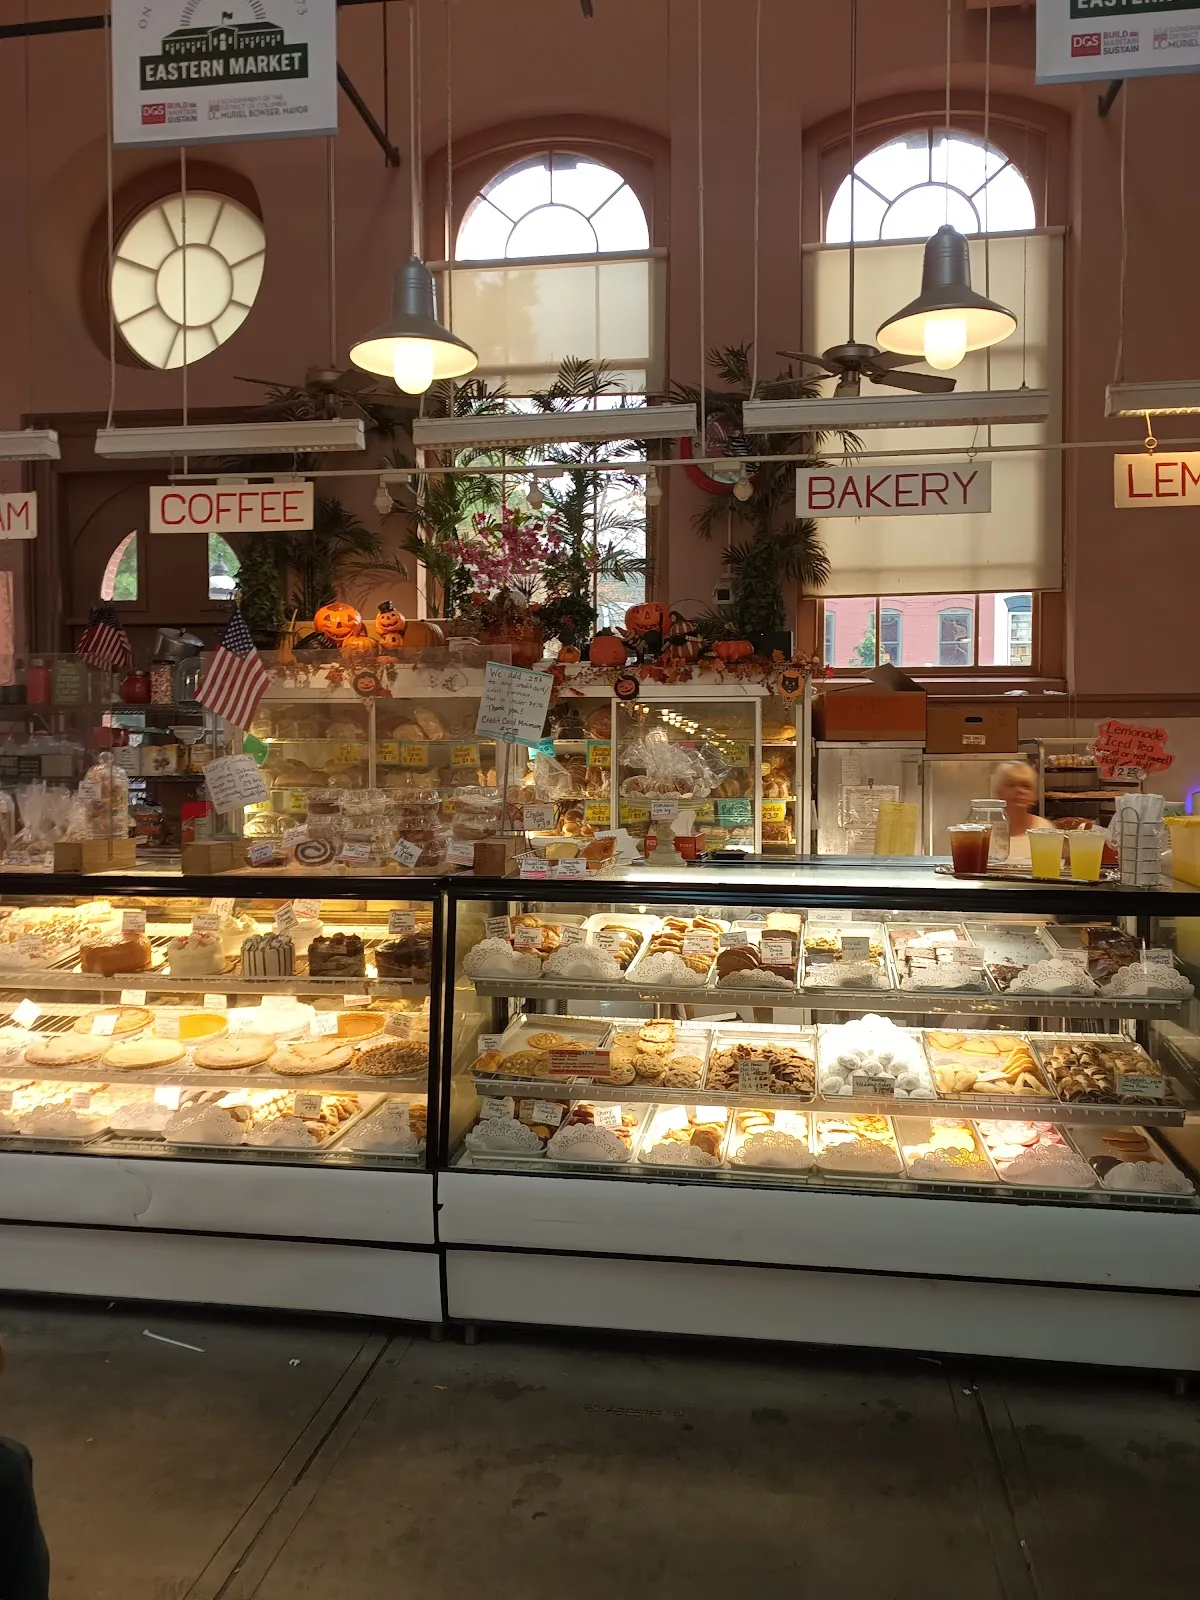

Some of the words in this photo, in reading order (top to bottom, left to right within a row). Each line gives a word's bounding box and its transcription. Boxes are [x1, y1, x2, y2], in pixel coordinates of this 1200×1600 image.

[1103, 30, 1128, 39] BUILD
[1073, 35, 1099, 48] DGS
[1103, 45, 1140, 55] SUSTAIN
[145, 59, 225, 82] EASTERN
[229, 52, 303, 74] MARKET
[142, 105, 165, 117] DGS
[167, 102, 189, 110] BUILD
[220, 111, 248, 120] MURIEL
[282, 105, 308, 115] MAYOR
[167, 115, 198, 124] SUSTAIN
[808, 470, 979, 510] BAKERY
[160, 490, 305, 525] COFFEE
[0, 501, 29, 531] M
[490, 668, 502, 678] We
[508, 672, 522, 681] add
[501, 681, 512, 689] any
[485, 704, 505, 713] Thank
[481, 715, 500, 724] Credit
[502, 717, 516, 726] Card
[1107, 723, 1164, 741] Lemonade
[1106, 736, 1132, 749] Iced
[1137, 741, 1154, 752] Tea
